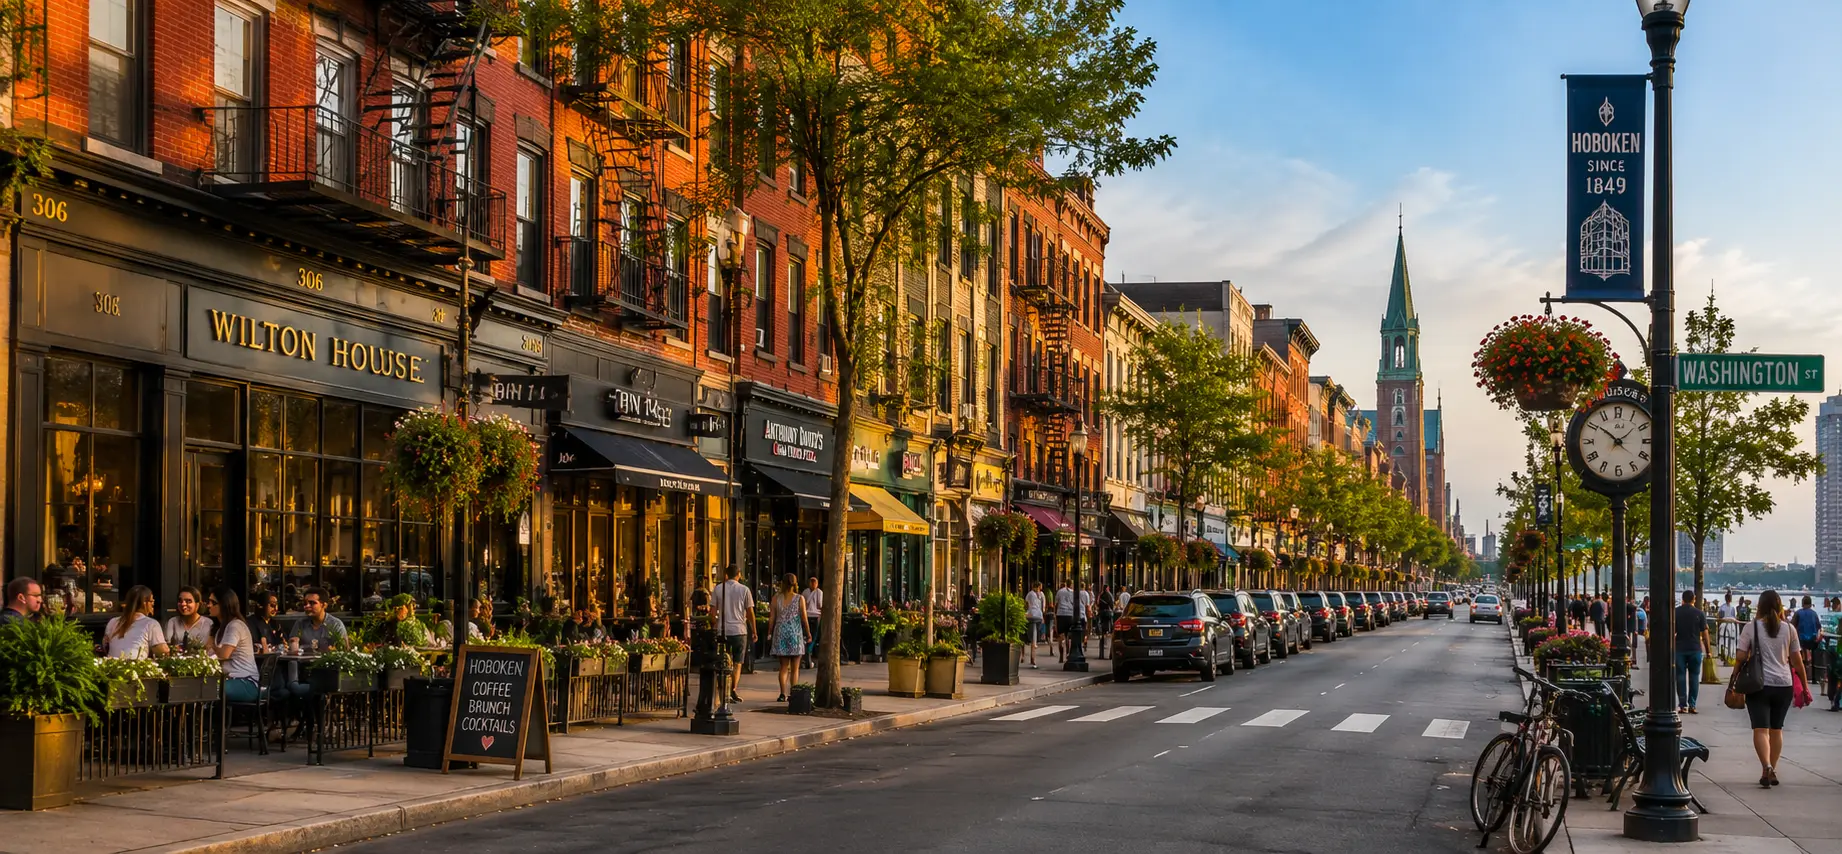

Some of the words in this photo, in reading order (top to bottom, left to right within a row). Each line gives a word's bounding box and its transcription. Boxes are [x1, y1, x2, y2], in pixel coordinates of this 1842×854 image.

[1572, 132, 1641, 154] HOBOKEN
[1587, 159, 1626, 172] SINCE
[1586, 176, 1627, 195] 1849
[32, 192, 68, 223] 306
[297, 267, 324, 292] 306
[211, 308, 317, 361] WILTON
[1683, 360, 1799, 386] WASHINGTON
[1804, 369, 1819, 380] ST
[469, 659, 523, 676] HOBOKEN
[473, 681, 512, 697] COFFEE
[469, 699, 511, 715] BRUNCH
[462, 717, 515, 733] COCKTAILS
